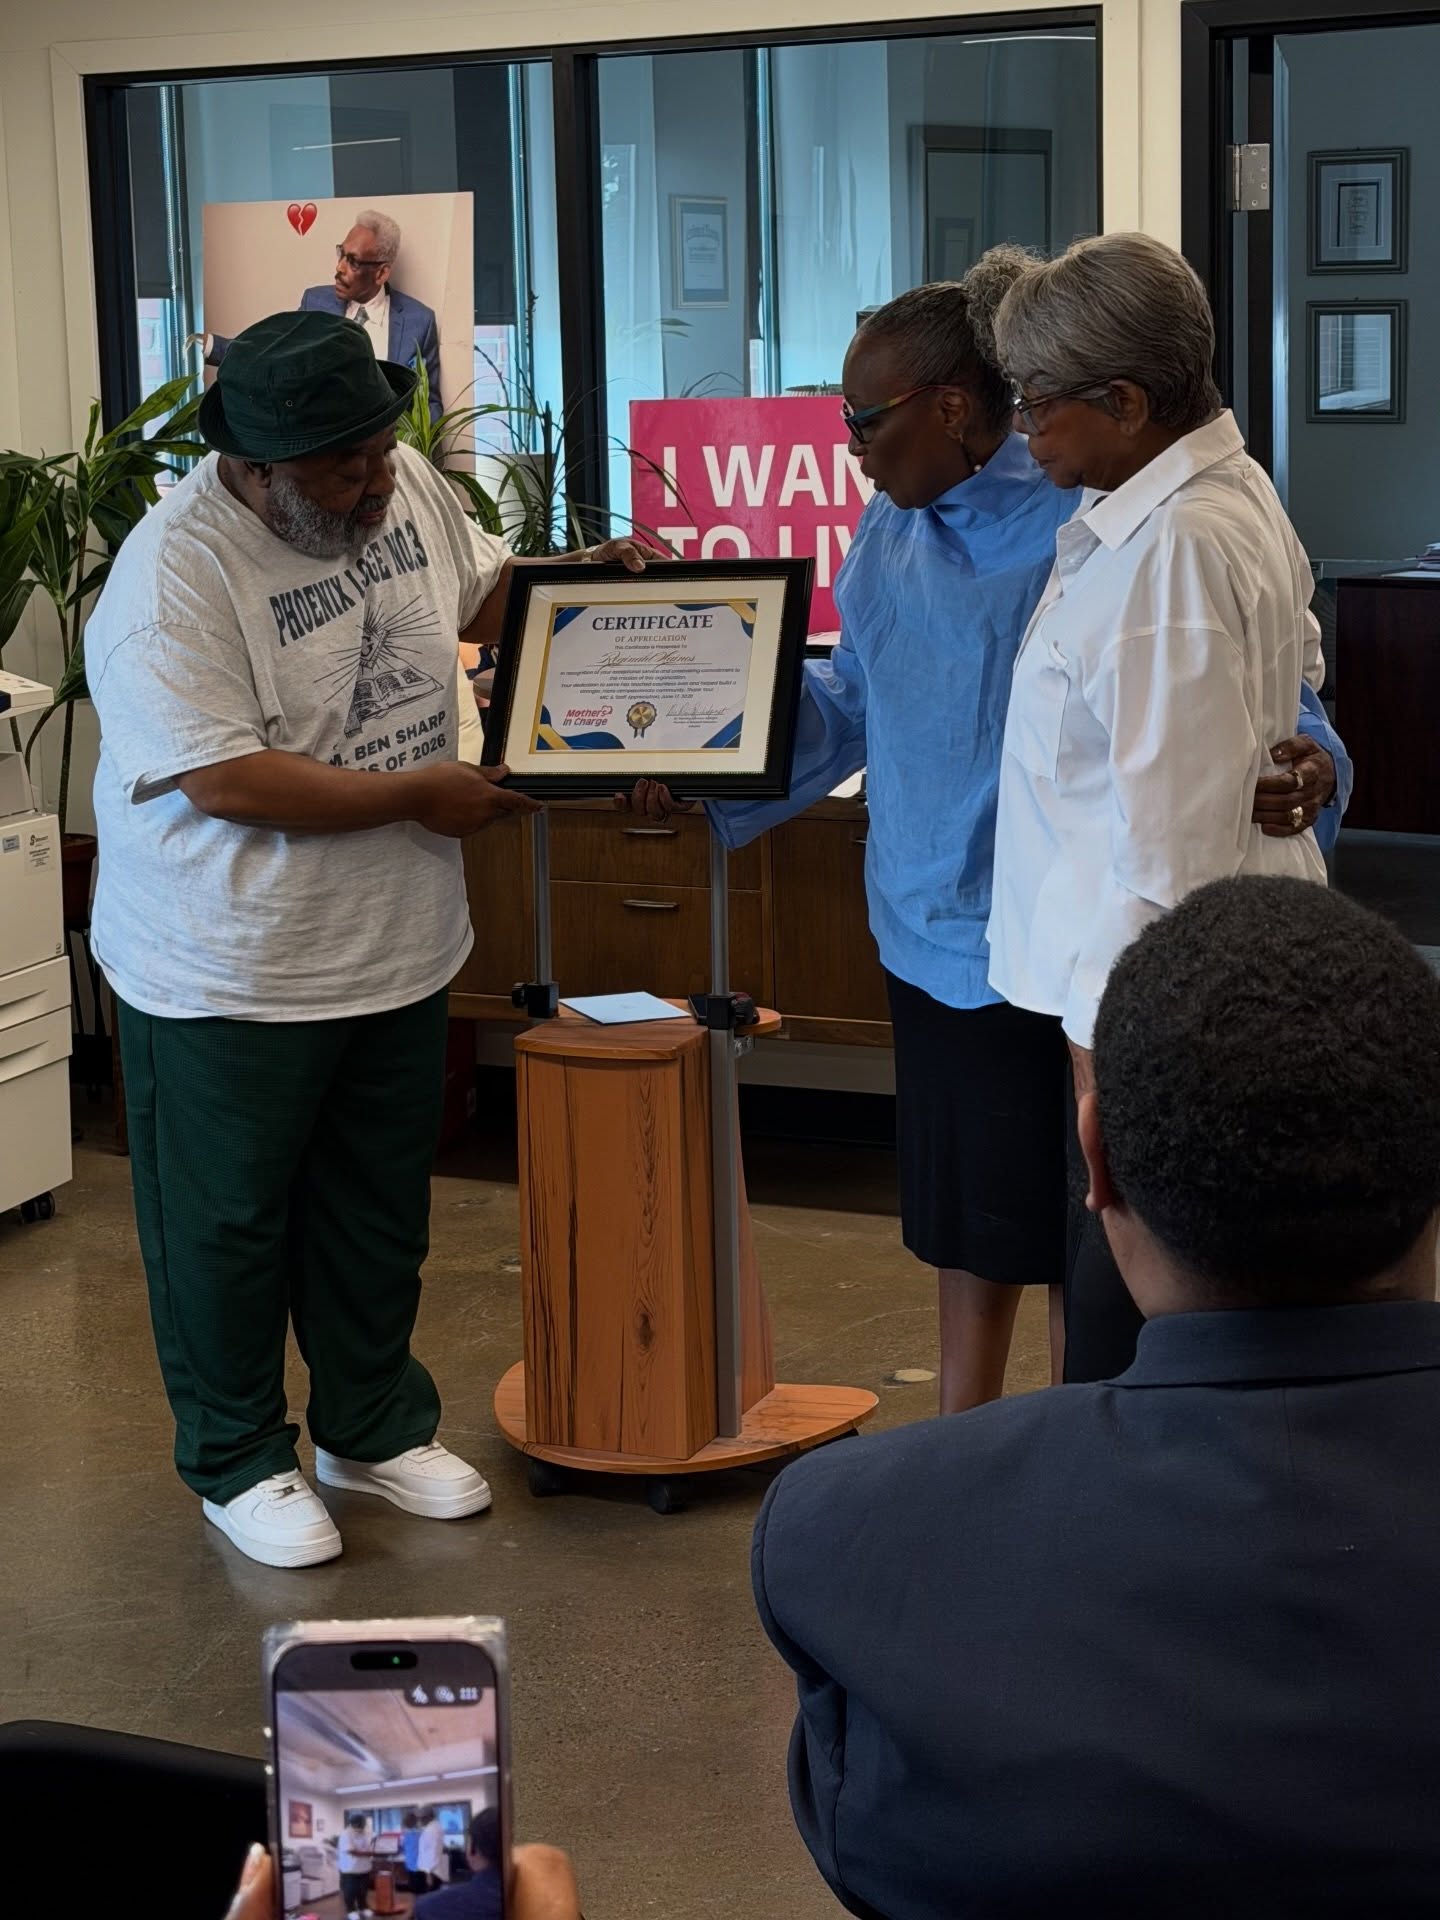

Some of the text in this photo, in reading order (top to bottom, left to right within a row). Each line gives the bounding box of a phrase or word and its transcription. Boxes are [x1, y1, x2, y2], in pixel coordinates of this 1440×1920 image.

[663, 443, 875, 508] I WAN
[269, 575, 356, 648] PHOENIX
[383, 519, 429, 576] NO.3
[592, 614, 713, 631] CERTIFICATE
[614, 634, 687, 643] OF APPRECIATION
[566, 709, 606, 718] Mothers
[574, 718, 608, 727] Charge
[354, 734, 391, 761] BEN
[395, 710, 446, 745] SHARP
[385, 733, 447, 772] OF 2026
